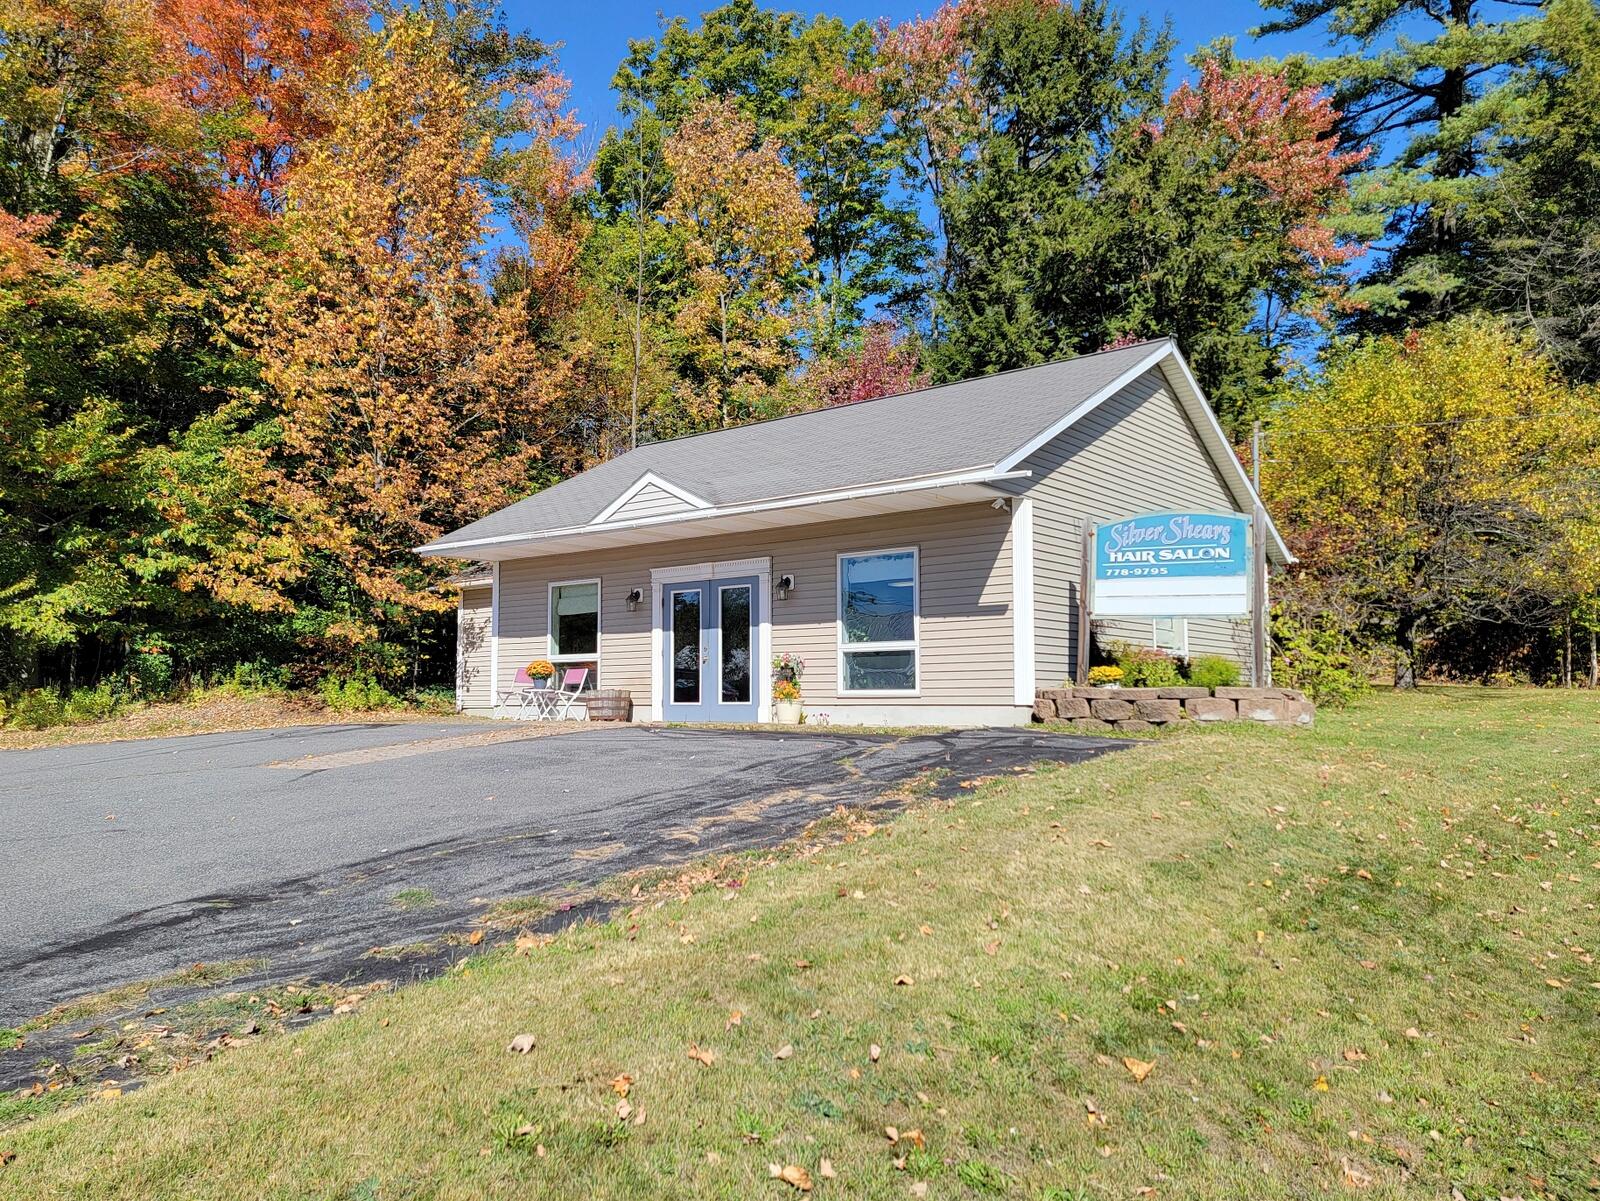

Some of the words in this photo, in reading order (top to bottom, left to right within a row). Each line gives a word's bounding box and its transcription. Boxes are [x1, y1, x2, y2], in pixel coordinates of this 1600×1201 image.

[1105, 522, 1164, 553] Silver
[1162, 516, 1232, 544] Shears
[1109, 550, 1157, 563] HAIR
[1159, 547, 1230, 561] SALON
[1105, 567, 1168, 576] 778-9795
